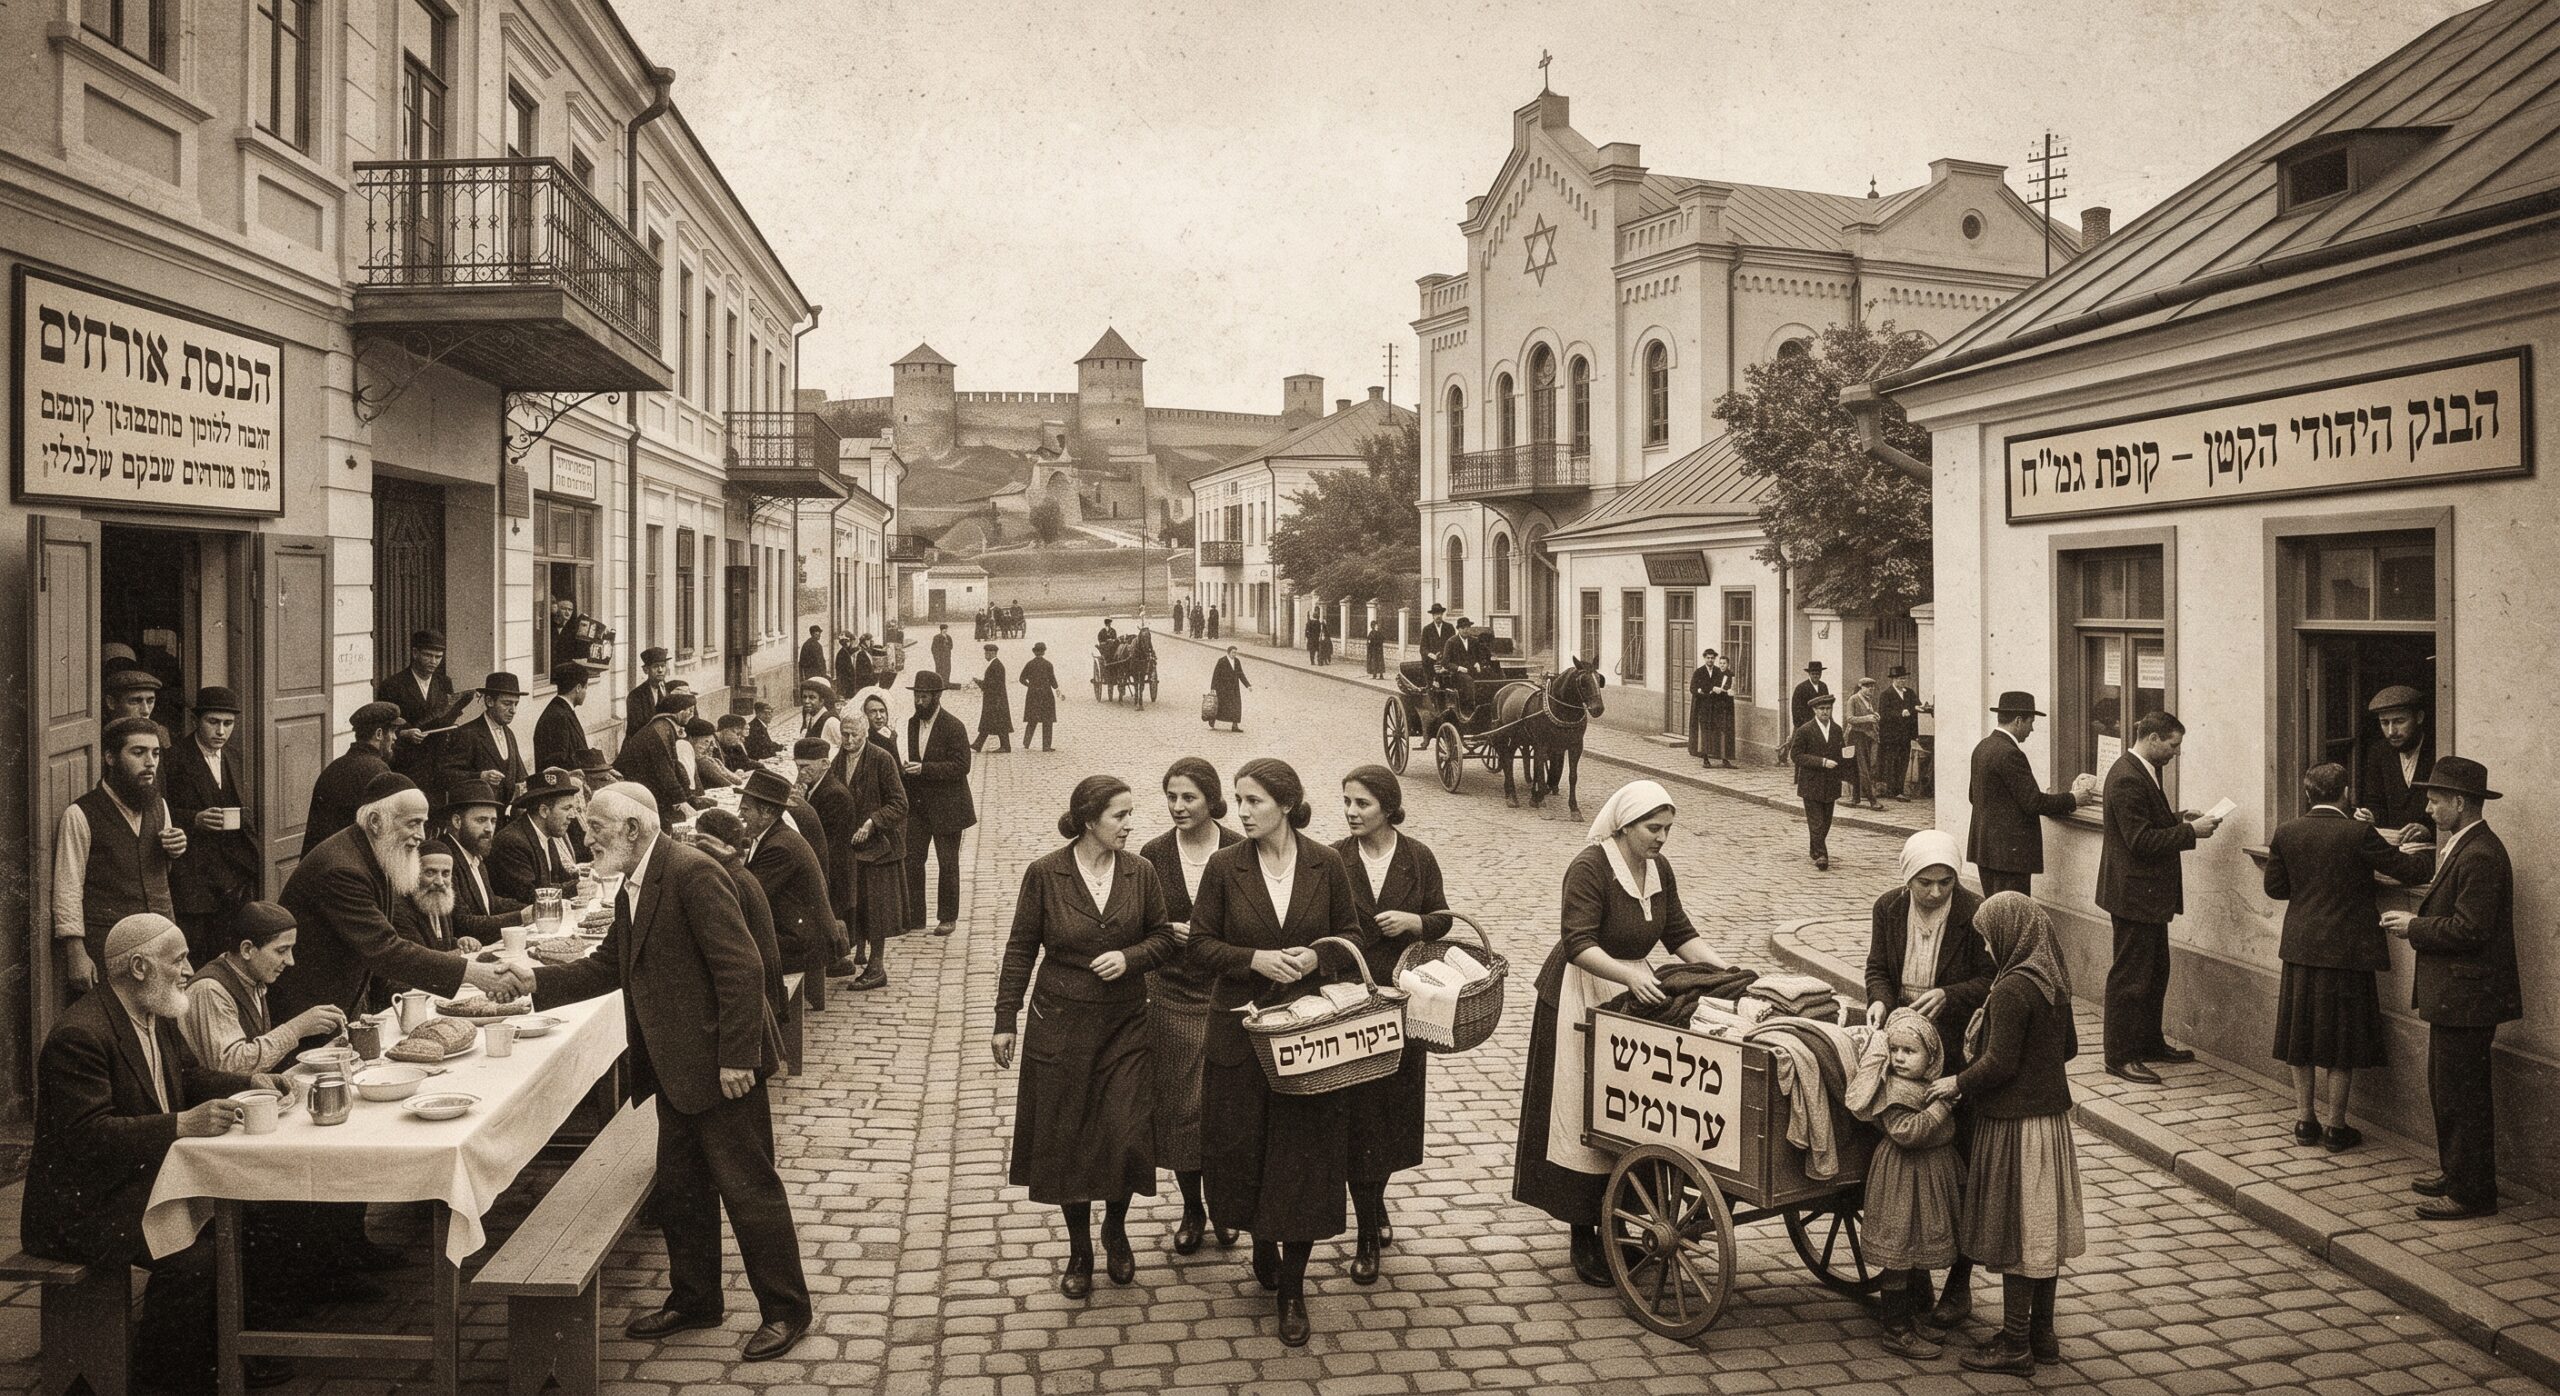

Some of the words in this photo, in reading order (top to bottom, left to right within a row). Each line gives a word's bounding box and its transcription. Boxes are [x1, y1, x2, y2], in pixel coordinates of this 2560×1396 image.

[38, 303, 169, 387] אורחים
[180, 340, 271, 405] הכנסת
[2203, 423, 2278, 488] הקטן
[2290, 404, 2393, 462] היהודי
[2407, 388, 2500, 464] הבנק
[2095, 441, 2160, 495] קופת
[1278, 1035, 1340, 1067] חולים
[1344, 1021, 1400, 1054] ביקור
[1610, 1033, 1723, 1096] מלביש
[1605, 1084, 1726, 1151] ערומים
